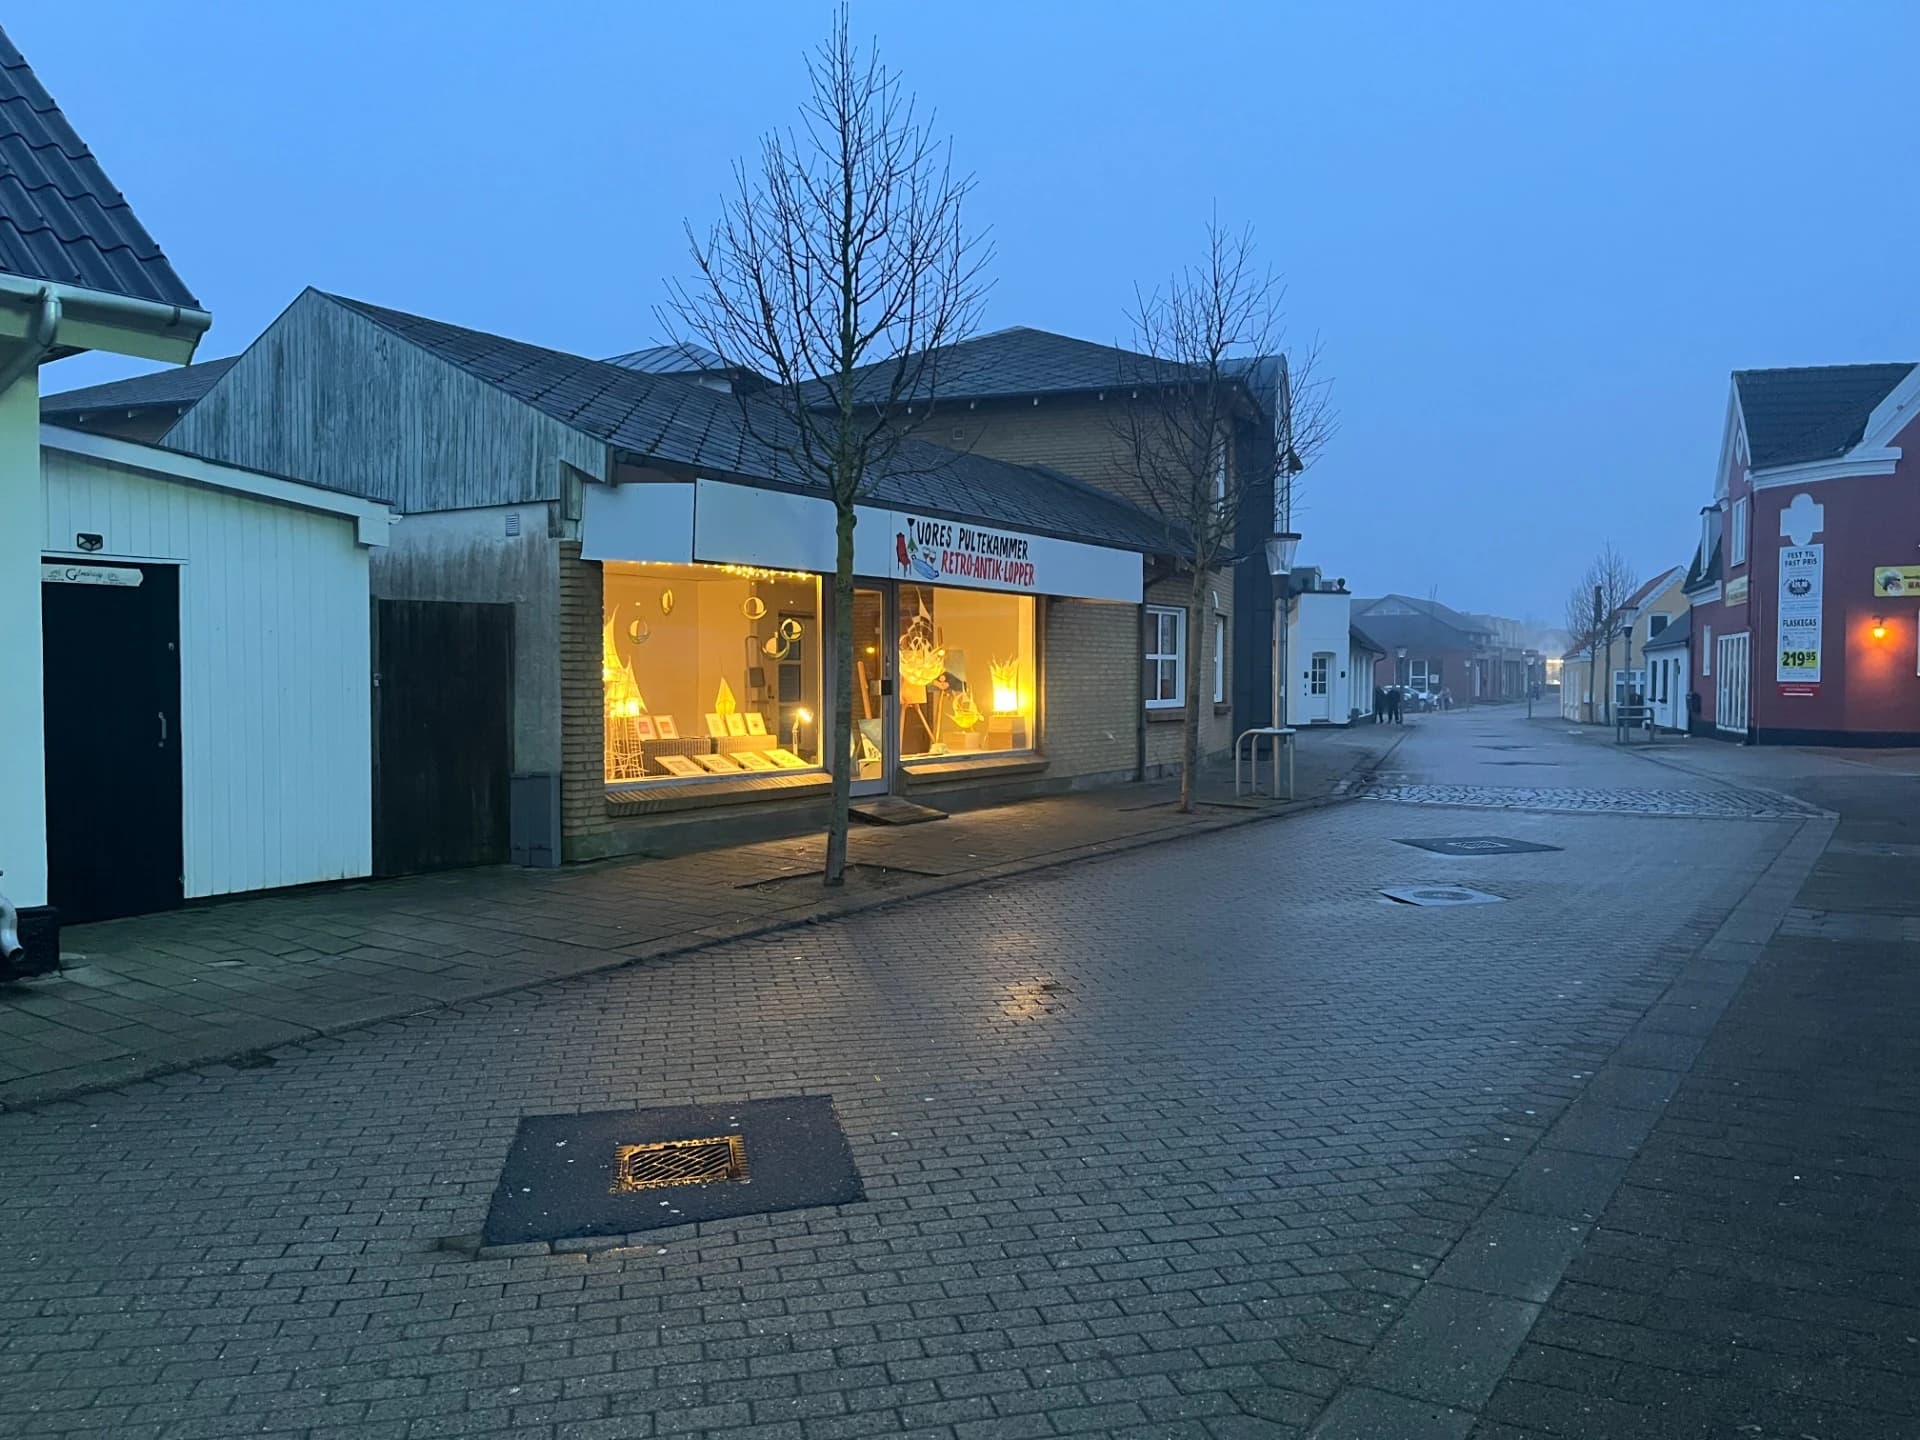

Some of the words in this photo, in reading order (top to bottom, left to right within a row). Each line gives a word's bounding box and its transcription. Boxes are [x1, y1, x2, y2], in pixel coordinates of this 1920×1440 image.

[917, 521, 952, 548] VORES
[958, 528, 1028, 560] PULTEKAMMER
[1784, 559, 1800, 567] FAST
[1783, 619, 1816, 628] FLASKEGAS
